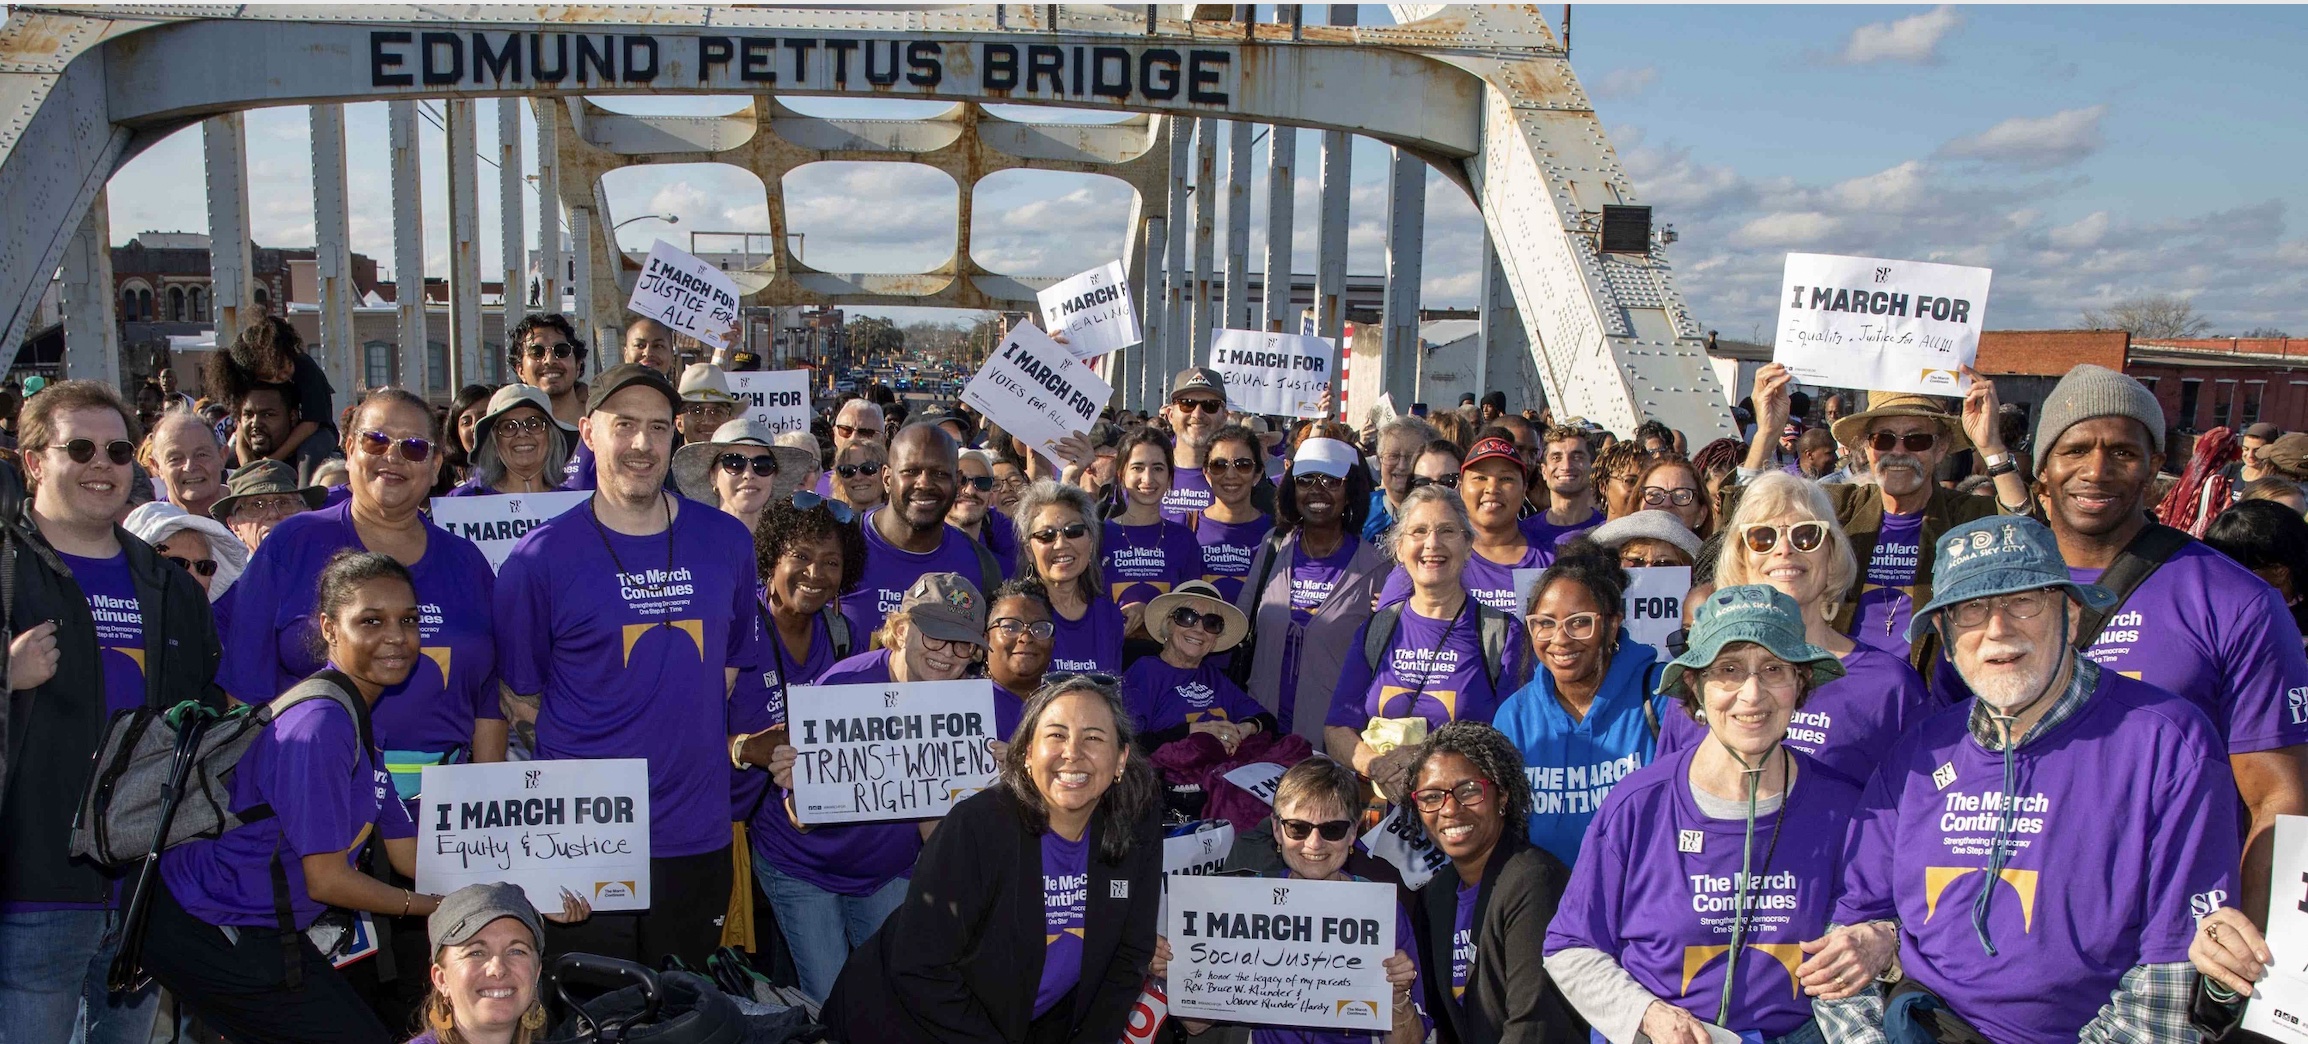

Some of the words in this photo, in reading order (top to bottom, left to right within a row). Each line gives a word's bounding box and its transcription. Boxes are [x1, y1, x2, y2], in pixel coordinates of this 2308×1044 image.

[371, 31, 660, 87] EDMUND
[699, 38, 943, 88] PETTUS
[982, 43, 1231, 105] BRIDGE
[649, 258, 660, 273] I
[660, 263, 712, 297] MARCH
[712, 288, 735, 312] FOR
[640, 274, 706, 313] JUSTICE
[709, 307, 735, 329] FOR
[1049, 306, 1058, 322] I
[1061, 284, 1119, 316] MARCH
[1791, 286, 1805, 308] I
[1810, 287, 1909, 317] MARCH
[1915, 295, 1971, 324] FOR
[661, 305, 695, 330] ALL
[1062, 304, 1129, 336] HEALING
[1896, 332, 1914, 345] for
[735, 352, 753, 361] ARMY
[1217, 349, 1226, 363] I
[1230, 350, 1288, 369] MARCH
[1292, 355, 1325, 372] FOR
[1002, 342, 1020, 360] I
[1013, 350, 1073, 400] MARCH
[1067, 390, 1096, 421] FOR
[1223, 371, 1270, 387] EQUAL
[1277, 377, 1329, 392] JUSTICE
[731, 392, 764, 407] RCH
[769, 391, 801, 407] FOR
[988, 366, 1026, 398] VOTES
[1047, 410, 1067, 430] ALL
[758, 413, 802, 435] Rights
[1161, 497, 1210, 507] Continues
[1180, 488, 1210, 499] March
[446, 522, 457, 536] I
[463, 518, 541, 541] MARCH
[1113, 550, 1133, 559] The
[1134, 547, 1165, 558] March
[1201, 545, 1221, 554] The
[1222, 544, 1251, 556] March
[1885, 542, 1919, 554] Marc
[1947, 552, 1978, 570] ACOMA
[1980, 546, 2000, 557] SKY
[2002, 544, 2026, 553] CITY
[1114, 556, 1166, 567] Continues
[1203, 554, 1251, 564] Continues
[1869, 554, 1918, 567] ontinue
[616, 572, 645, 586] The
[645, 566, 692, 584] March
[1292, 579, 1302, 589] he
[1303, 580, 1334, 591] March
[621, 584, 694, 600] Continues
[878, 588, 902, 601] The
[1470, 588, 1494, 598] The
[91, 608, 143, 624] ntinues
[416, 603, 442, 614] rch
[1634, 597, 1679, 620] FOR
[1715, 602, 1749, 618] ACOMA
[2107, 610, 2143, 627] rch
[110, 626, 143, 634] Democracy
[1395, 649, 1416, 660] The
[1416, 648, 1458, 662] March
[2095, 648, 2130, 656] Democracy
[1392, 660, 1456, 672] Continues
[884, 691, 899, 700] SP
[803, 720, 818, 744] I
[825, 715, 923, 744] MARCH
[930, 712, 983, 739] FOR
[1790, 711, 1831, 729] arch
[525, 770, 541, 780] SP
[1524, 766, 1565, 790] THE
[1567, 752, 1642, 790] MARCH
[853, 778, 952, 813] RIGHTS
[1945, 792, 1980, 812] The
[1980, 791, 2050, 812] March
[436, 804, 452, 830] I
[460, 797, 565, 830] MARCH
[575, 796, 634, 824] FOR
[1940, 812, 2044, 834] Continues
[436, 834, 511, 870] Equity
[521, 831, 530, 856] &
[535, 832, 632, 859] Justice
[1943, 836, 1990, 846] Strengthening
[1952, 846, 1966, 854] One
[1966, 846, 1984, 856] Step
[1690, 874, 1731, 894] The
[1734, 870, 1796, 890] March
[1273, 888, 1290, 897] SP
[2189, 889, 2228, 917] SP
[1182, 910, 1198, 936] I
[1206, 912, 1312, 942] MARCH
[1322, 917, 1380, 946] FOR
[1190, 943, 1260, 966] Social
[1262, 948, 1366, 972] Justice
[1184, 979, 1204, 992] Rev.
[1208, 981, 1232, 994] Bruce
[1234, 986, 1246, 995] W.
[1248, 984, 1290, 999] Klunder
[1190, 970, 1202, 979] to
[1208, 970, 1230, 982] honor
[1236, 970, 1250, 982] the
[1253, 972, 1282, 990] legacy
[1285, 974, 1299, 987] of
[1300, 976, 1314, 989] my
[1316, 976, 1352, 990] parents
[1226, 994, 1259, 1008] Joanne
[1260, 998, 1298, 1011] Klunder
[1300, 998, 1330, 1015] Hardy
